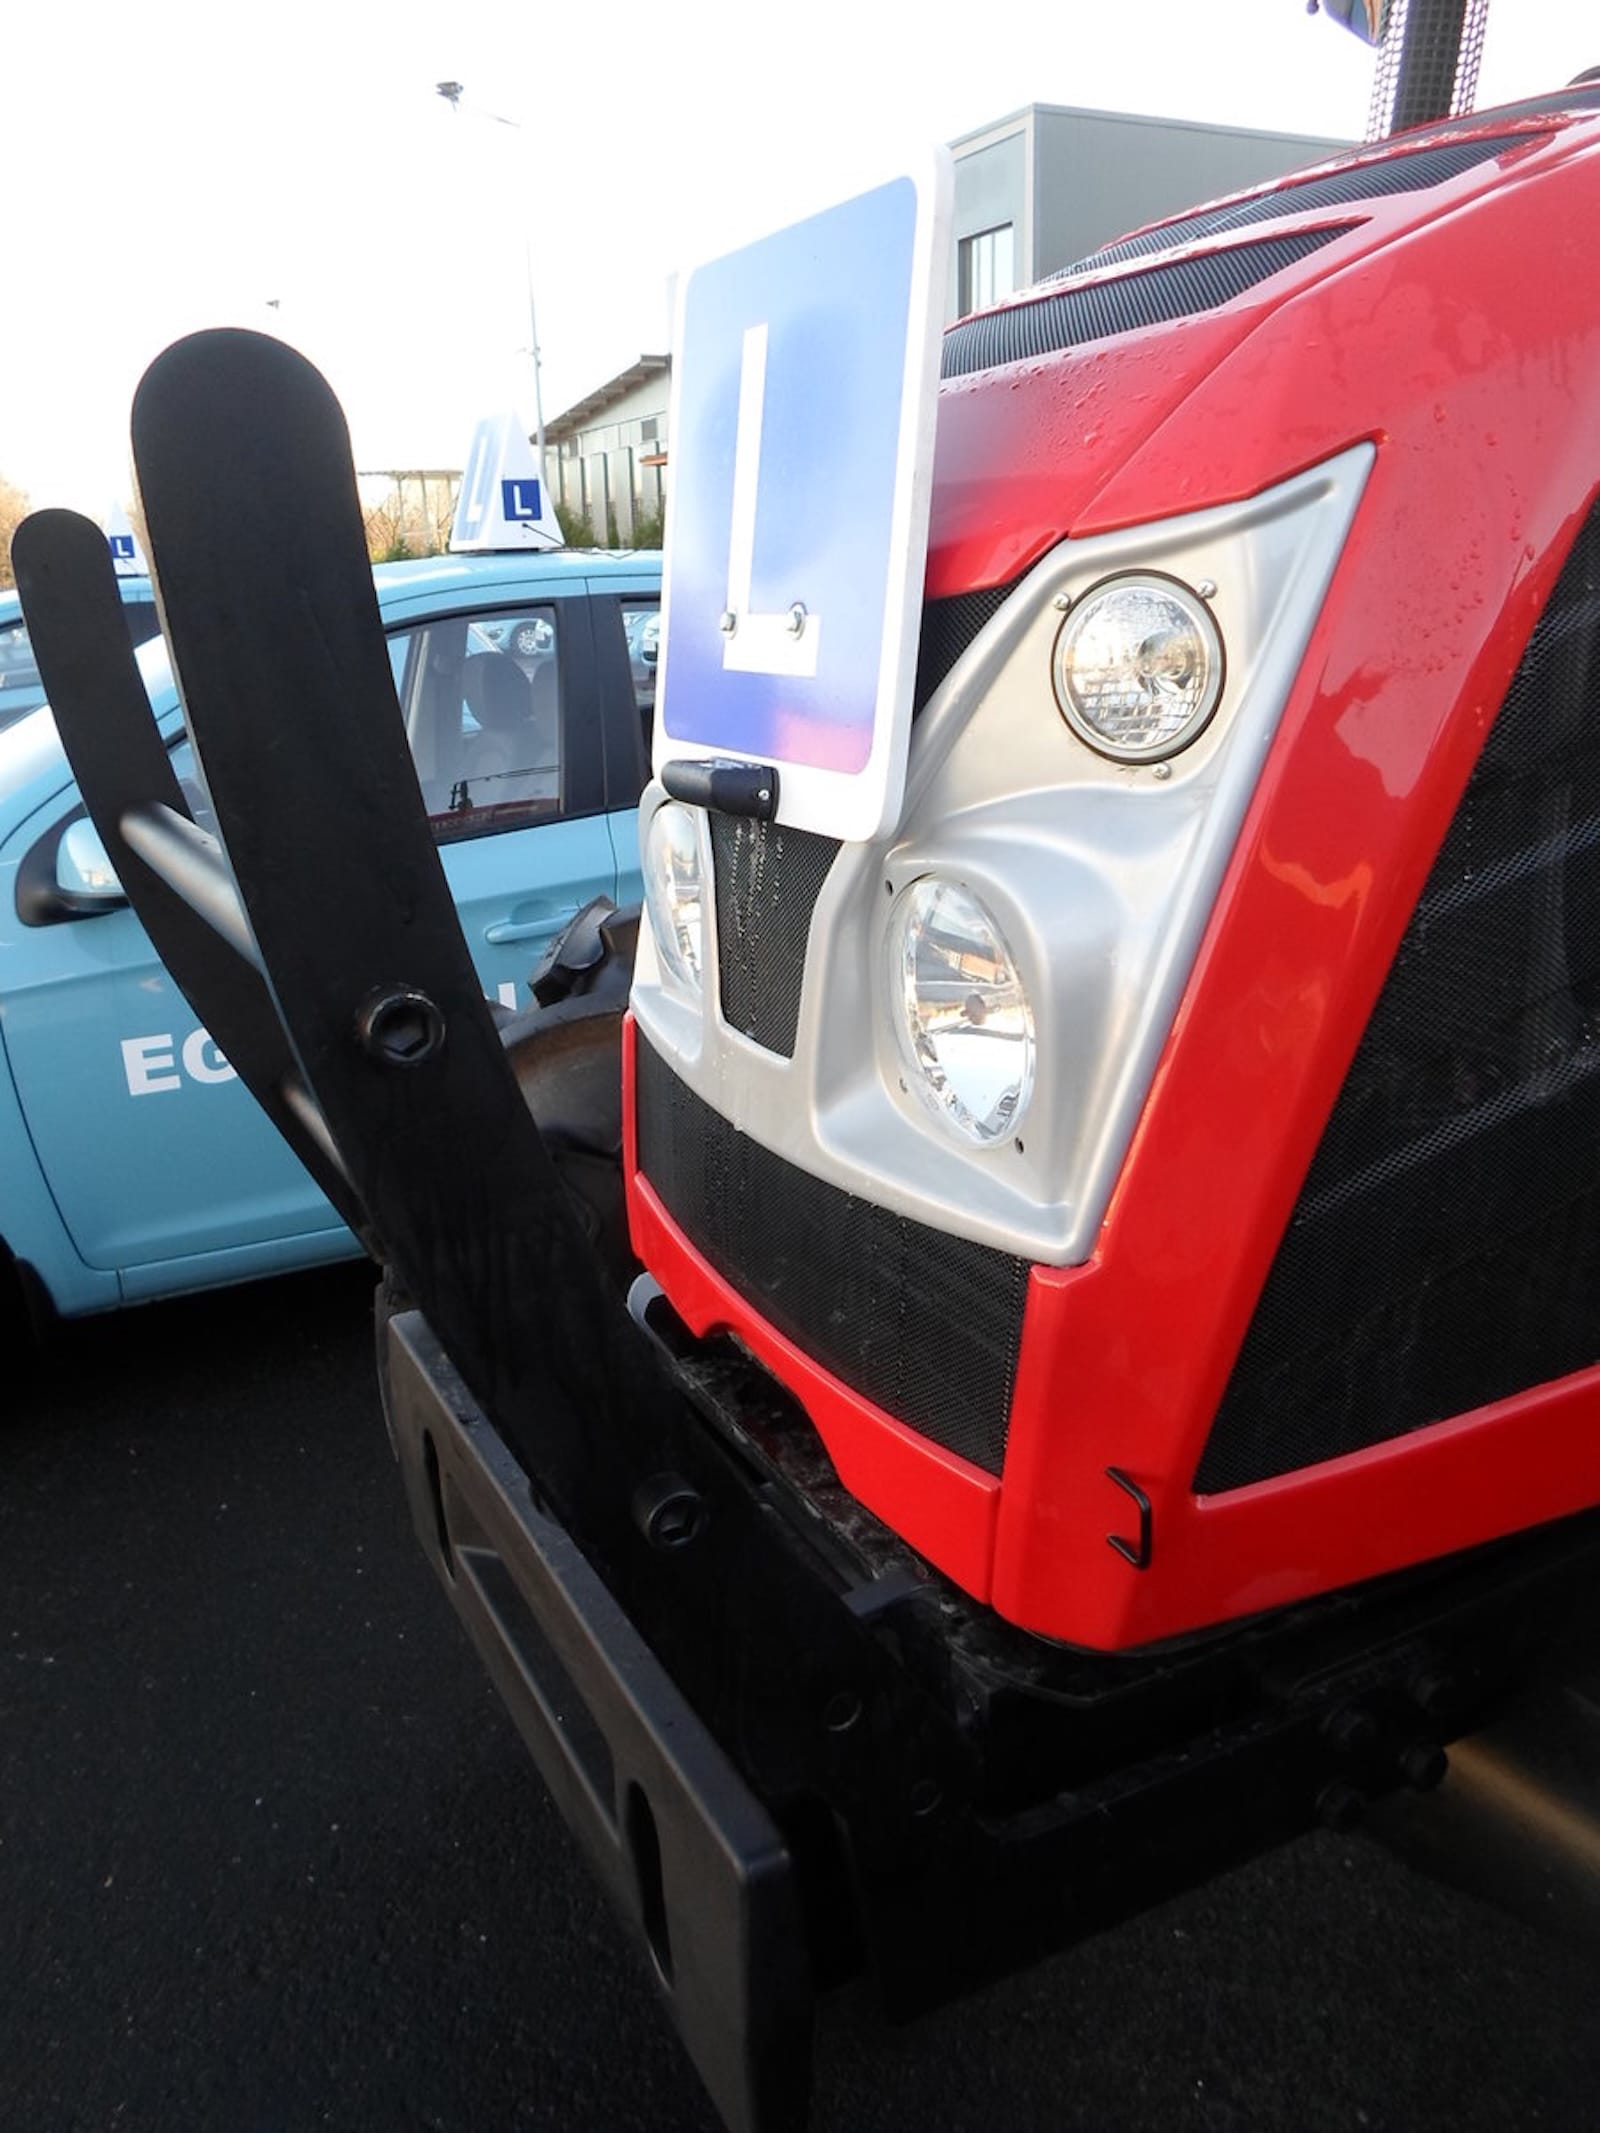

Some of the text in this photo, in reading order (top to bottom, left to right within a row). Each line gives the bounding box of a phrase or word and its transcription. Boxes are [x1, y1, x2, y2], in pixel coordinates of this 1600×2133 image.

[513, 484, 533, 516] L
[722, 322, 821, 678] L
[115, 538, 131, 556] L
[120, 1027, 238, 1096] EG
